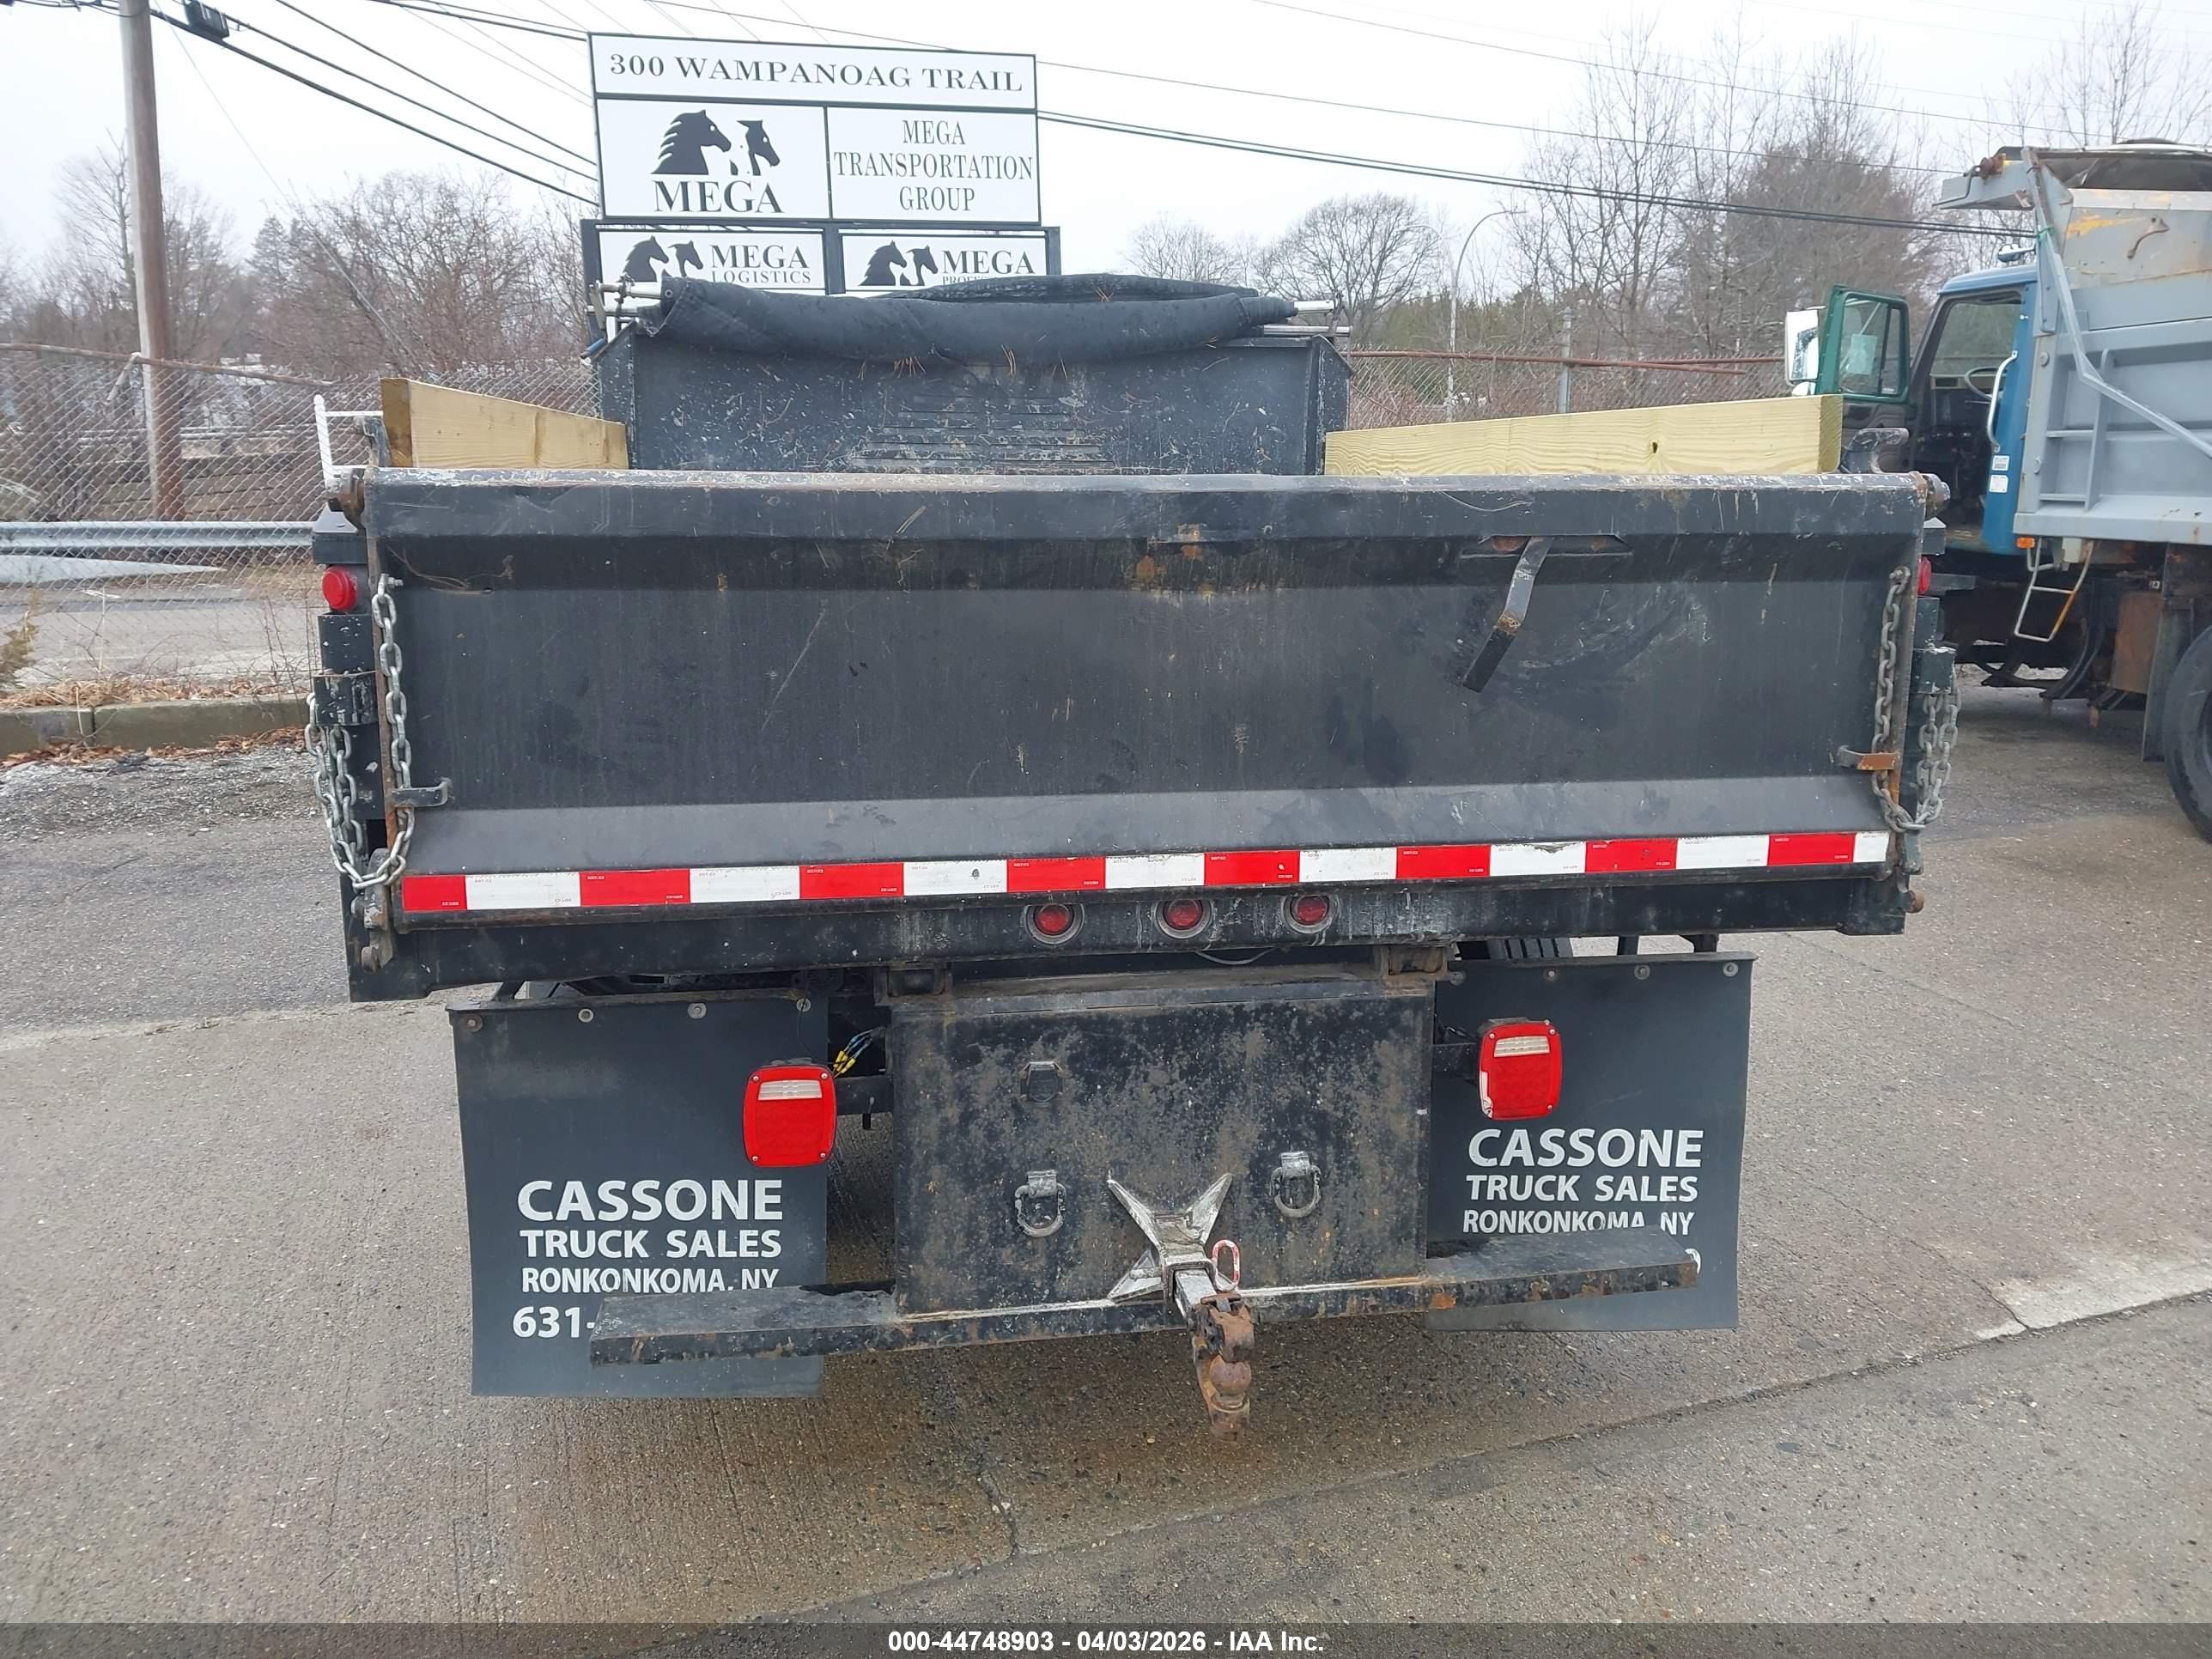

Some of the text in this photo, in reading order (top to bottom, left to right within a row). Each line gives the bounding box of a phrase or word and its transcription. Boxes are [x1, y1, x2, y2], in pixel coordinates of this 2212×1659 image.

[610, 54, 1023, 91] 300 WAMPANOAG TRAIL
[902, 120, 966, 145] MEGA
[834, 152, 1033, 179] TRANSPORTATION
[653, 179, 785, 213] MEGA
[899, 186, 975, 211] GROUP
[709, 245, 810, 269] MEGA
[942, 250, 1036, 274] MEGA
[711, 270, 811, 283] LOGISTICS
[1468, 1128, 1704, 1168] CASSONE
[517, 1179, 783, 1221] CASSONE
[1466, 1175, 1698, 1202] TRUCK SALES
[1462, 1209, 1695, 1236] RONKONKOMA NY
[520, 1230, 782, 1259] TRUCK SALES
[741, 1268, 780, 1290] NY
